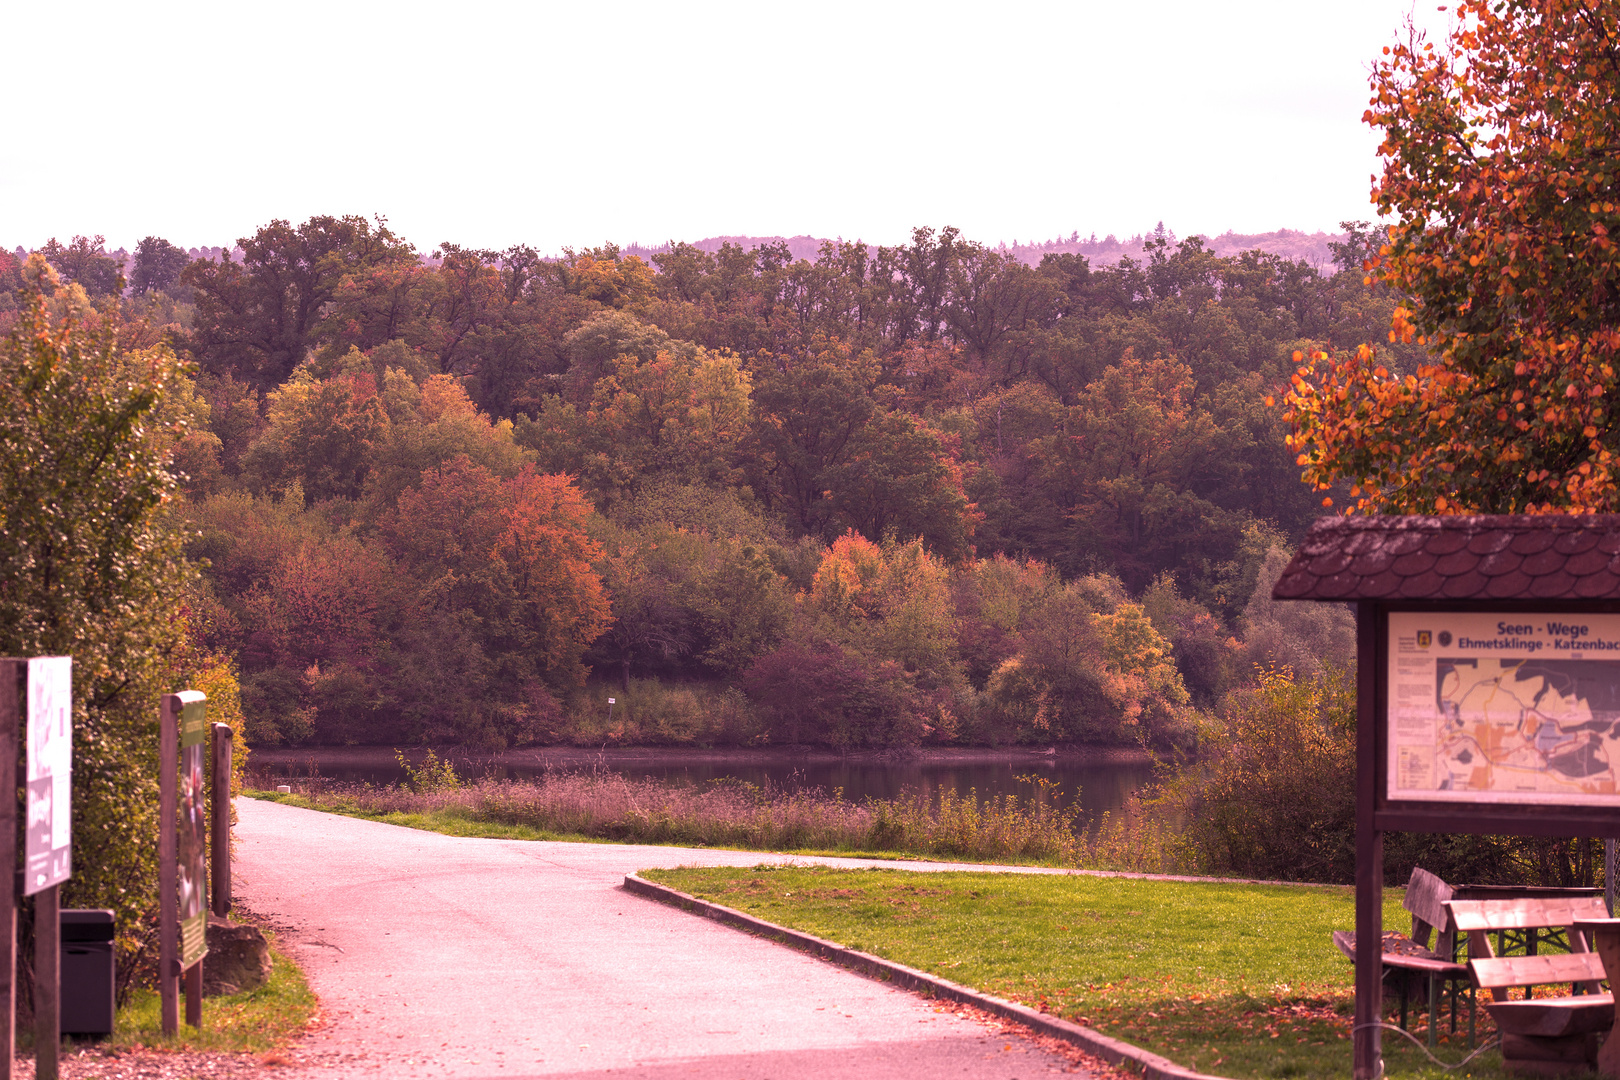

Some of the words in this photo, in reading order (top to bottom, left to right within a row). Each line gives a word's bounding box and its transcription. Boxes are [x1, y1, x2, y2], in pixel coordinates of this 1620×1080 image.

[1497, 622, 1533, 635] Seen
[1547, 622, 1588, 638] Wege
[1458, 637, 1543, 652] Ehmetsklinge
